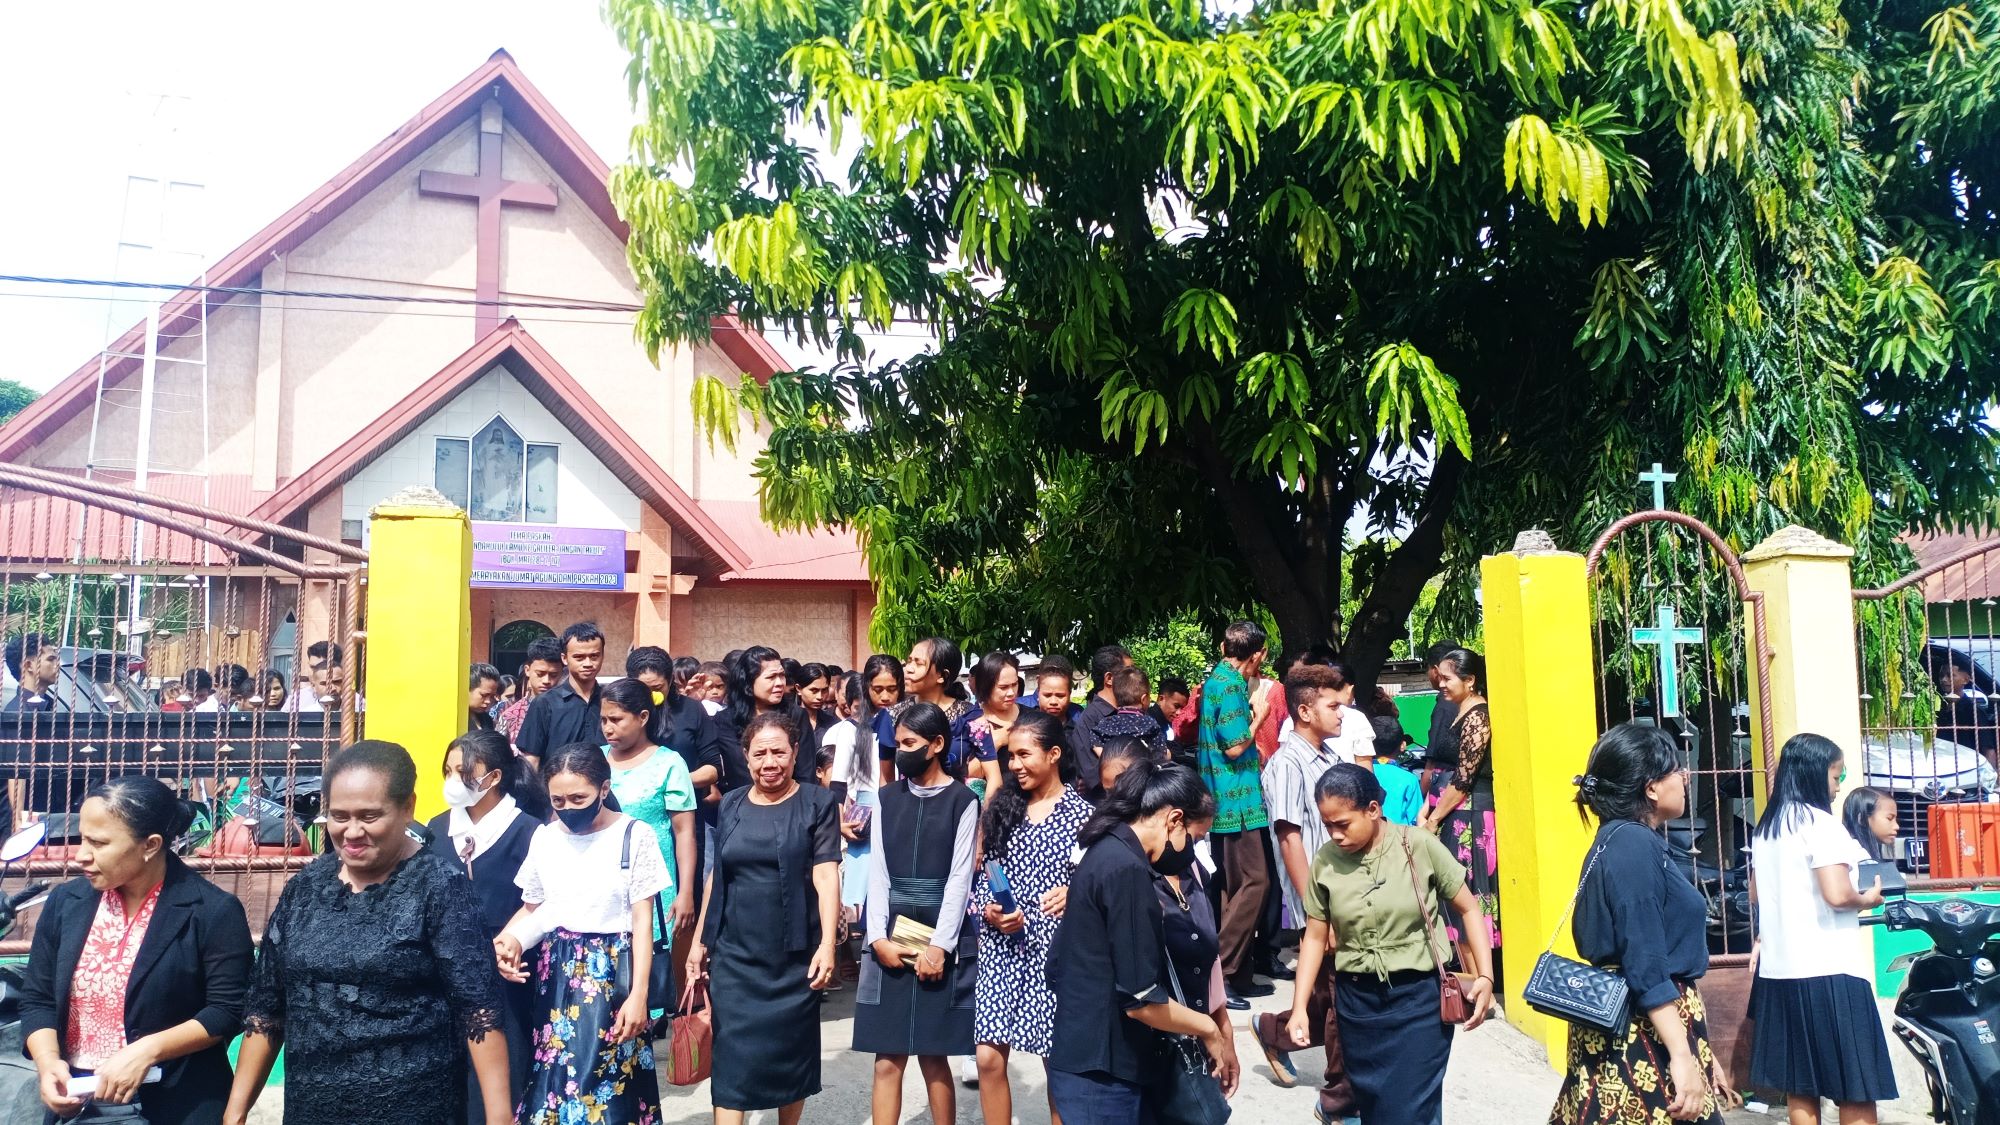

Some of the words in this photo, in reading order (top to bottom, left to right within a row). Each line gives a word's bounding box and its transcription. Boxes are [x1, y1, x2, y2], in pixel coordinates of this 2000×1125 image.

[511, 572, 533, 582] JUMAT
[534, 573, 557, 583] AGUNG
[558, 574, 572, 584] DAN
[573, 574, 599, 584] PASKAH
[600, 574, 617, 585] 2023
